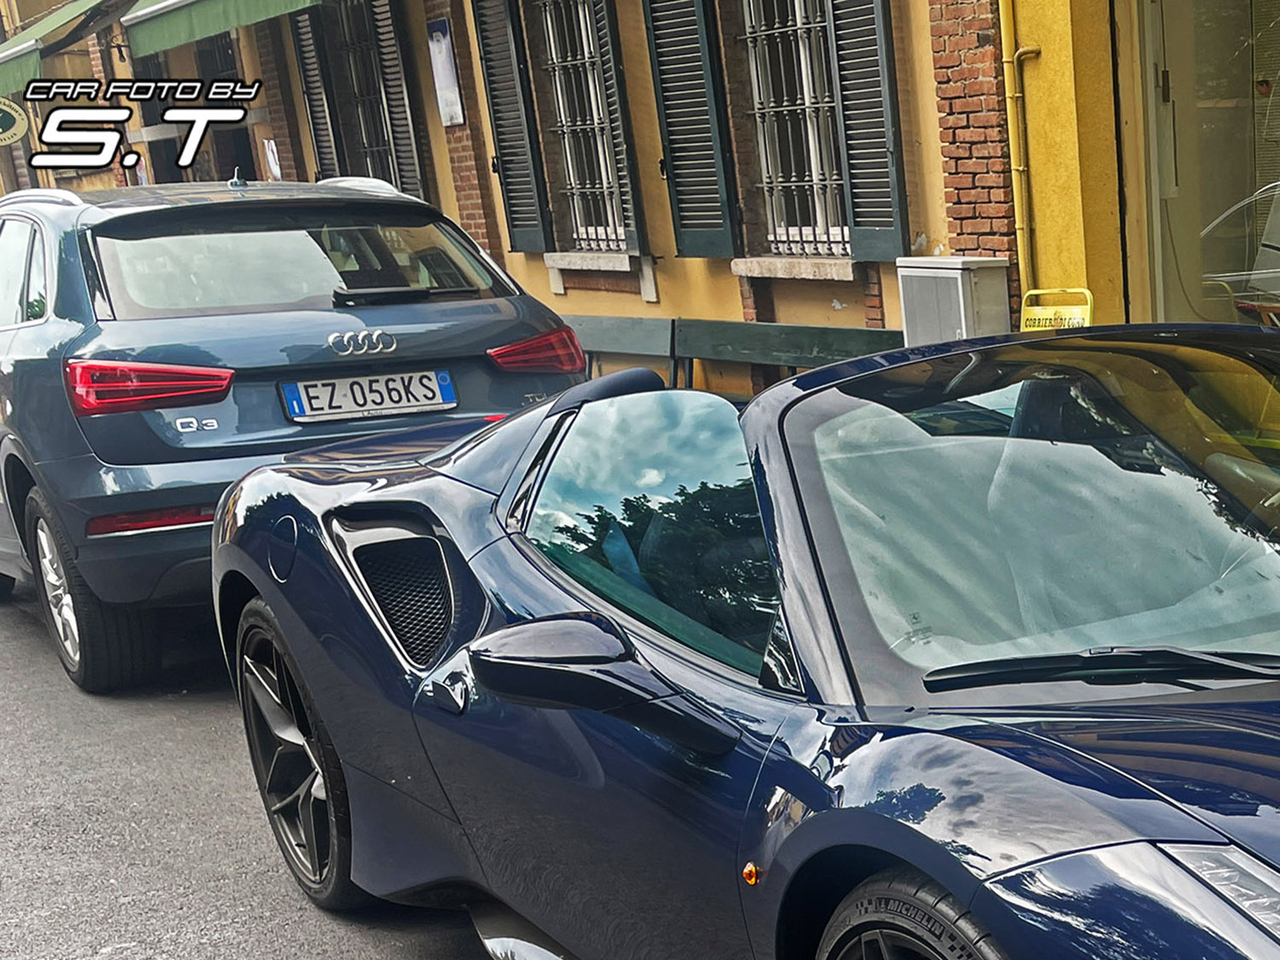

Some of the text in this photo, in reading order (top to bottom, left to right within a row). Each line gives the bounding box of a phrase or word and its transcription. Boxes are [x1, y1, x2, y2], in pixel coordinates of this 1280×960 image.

[303, 381, 343, 412] EZ
[349, 373, 438, 409] 056KS
[175, 417, 220, 433] Q3
[886, 899, 946, 937] MICHELIN
